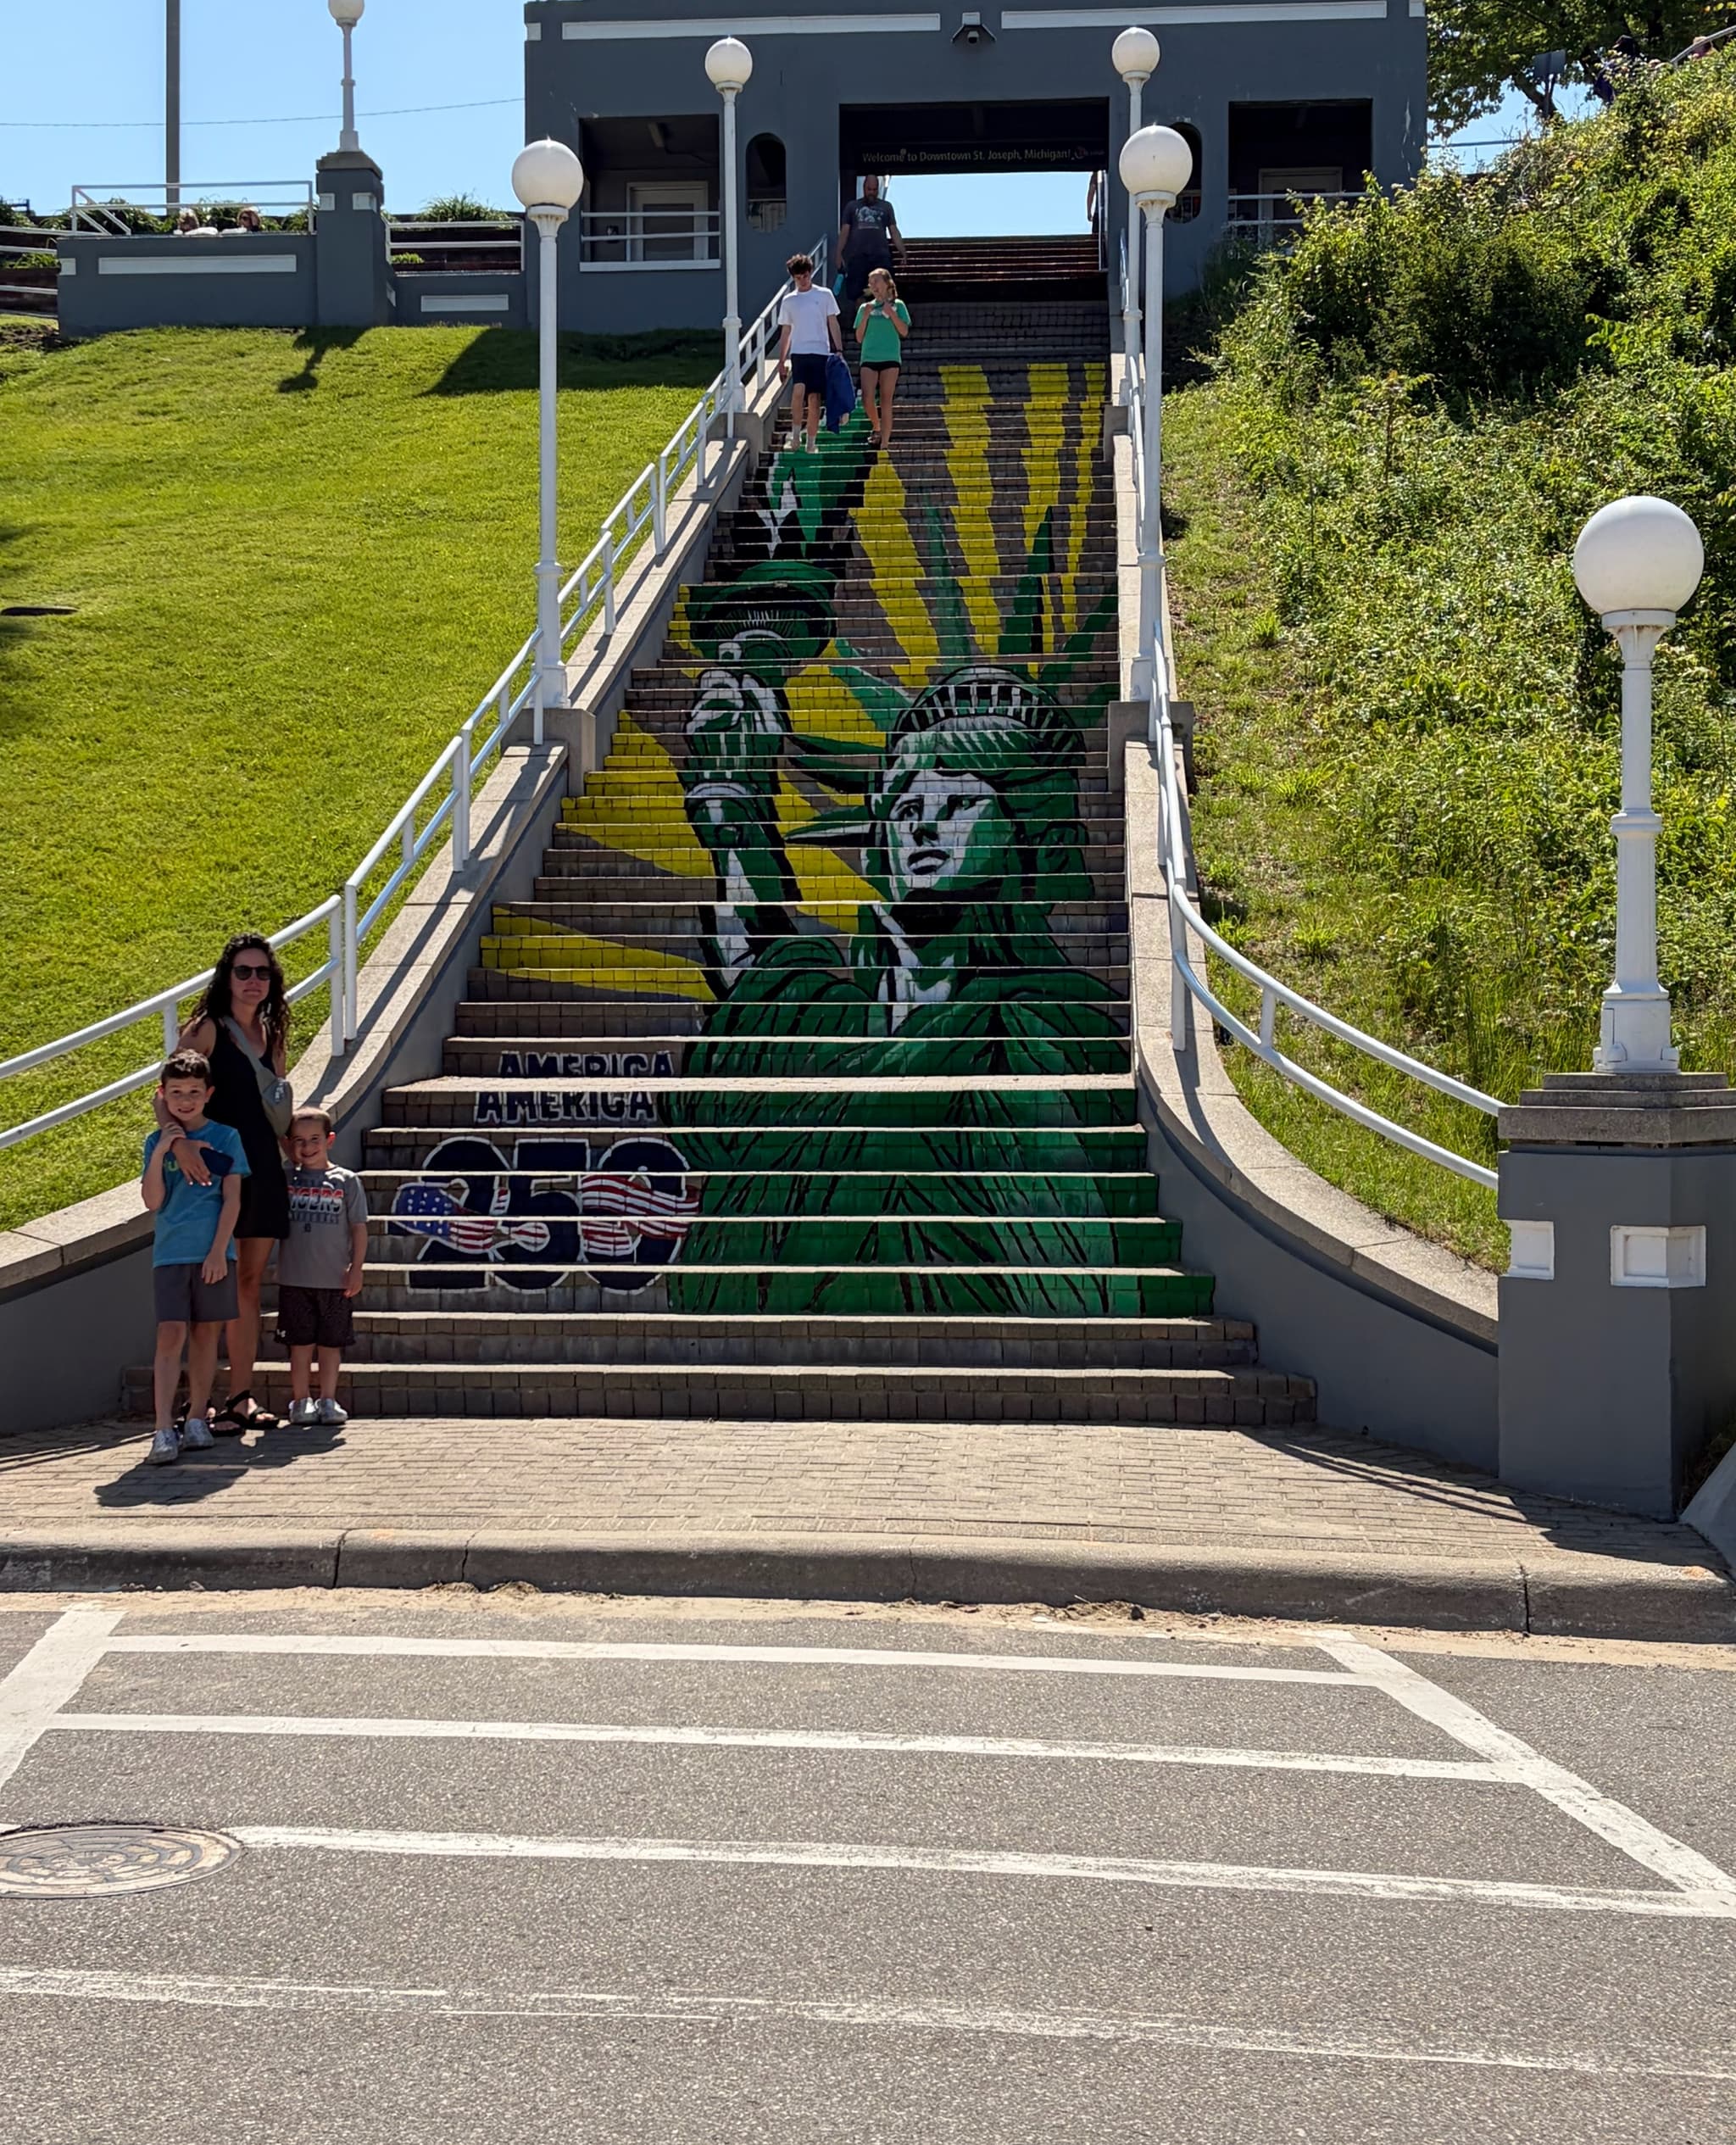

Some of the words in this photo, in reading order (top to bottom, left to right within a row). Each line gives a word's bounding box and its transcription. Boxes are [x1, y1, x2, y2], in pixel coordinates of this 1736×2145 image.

[862, 152, 904, 162] Welcome
[908, 153, 917, 161] to
[920, 151, 971, 161] Downtown
[973, 150, 985, 160] St.
[988, 149, 1022, 161] Joseph,
[1024, 149, 1071, 161] Michigan!
[474, 1091, 658, 1123] AMERICA
[386, 1135, 700, 1295] 250
